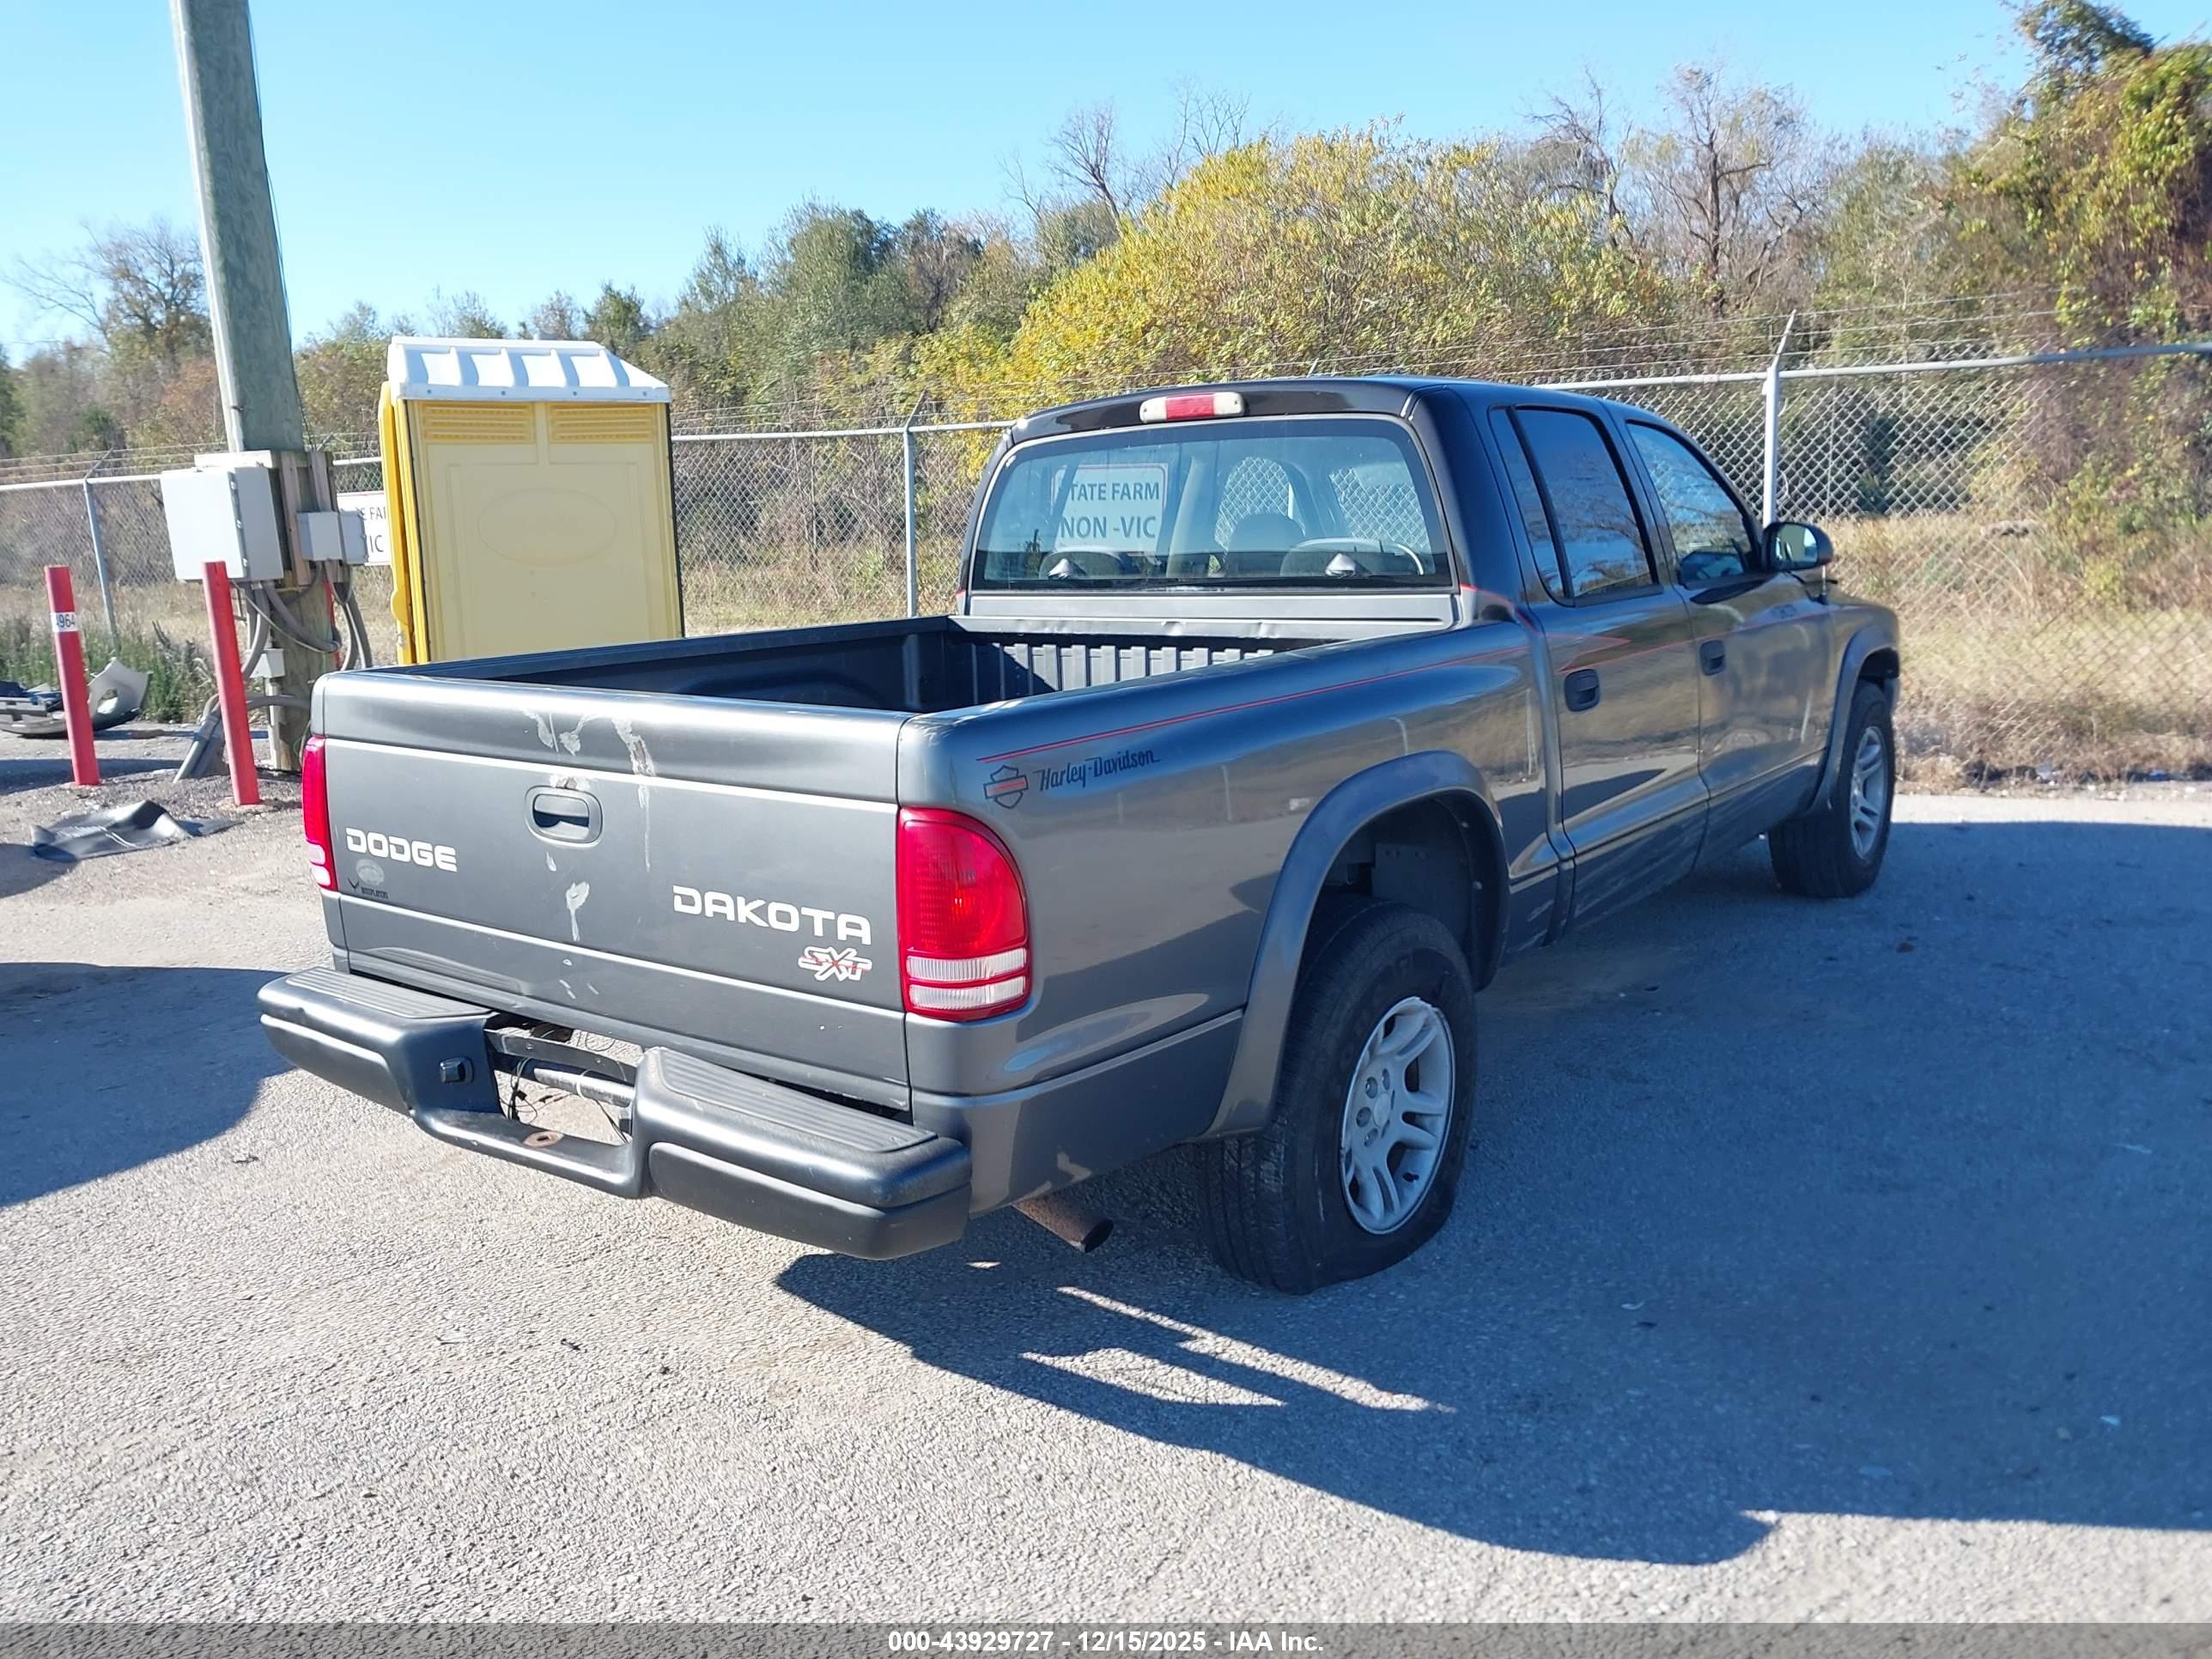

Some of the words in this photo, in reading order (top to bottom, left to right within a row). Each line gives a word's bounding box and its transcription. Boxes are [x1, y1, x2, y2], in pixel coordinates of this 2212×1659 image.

[1069, 482, 1107, 501] TATE
[1112, 482, 1159, 501] FARM
[1060, 516, 1107, 538] NON
[369, 534, 384, 553] IC
[345, 827, 458, 872] DODGE
[672, 884, 872, 945] DAKOTA
[798, 945, 872, 981] SXT
